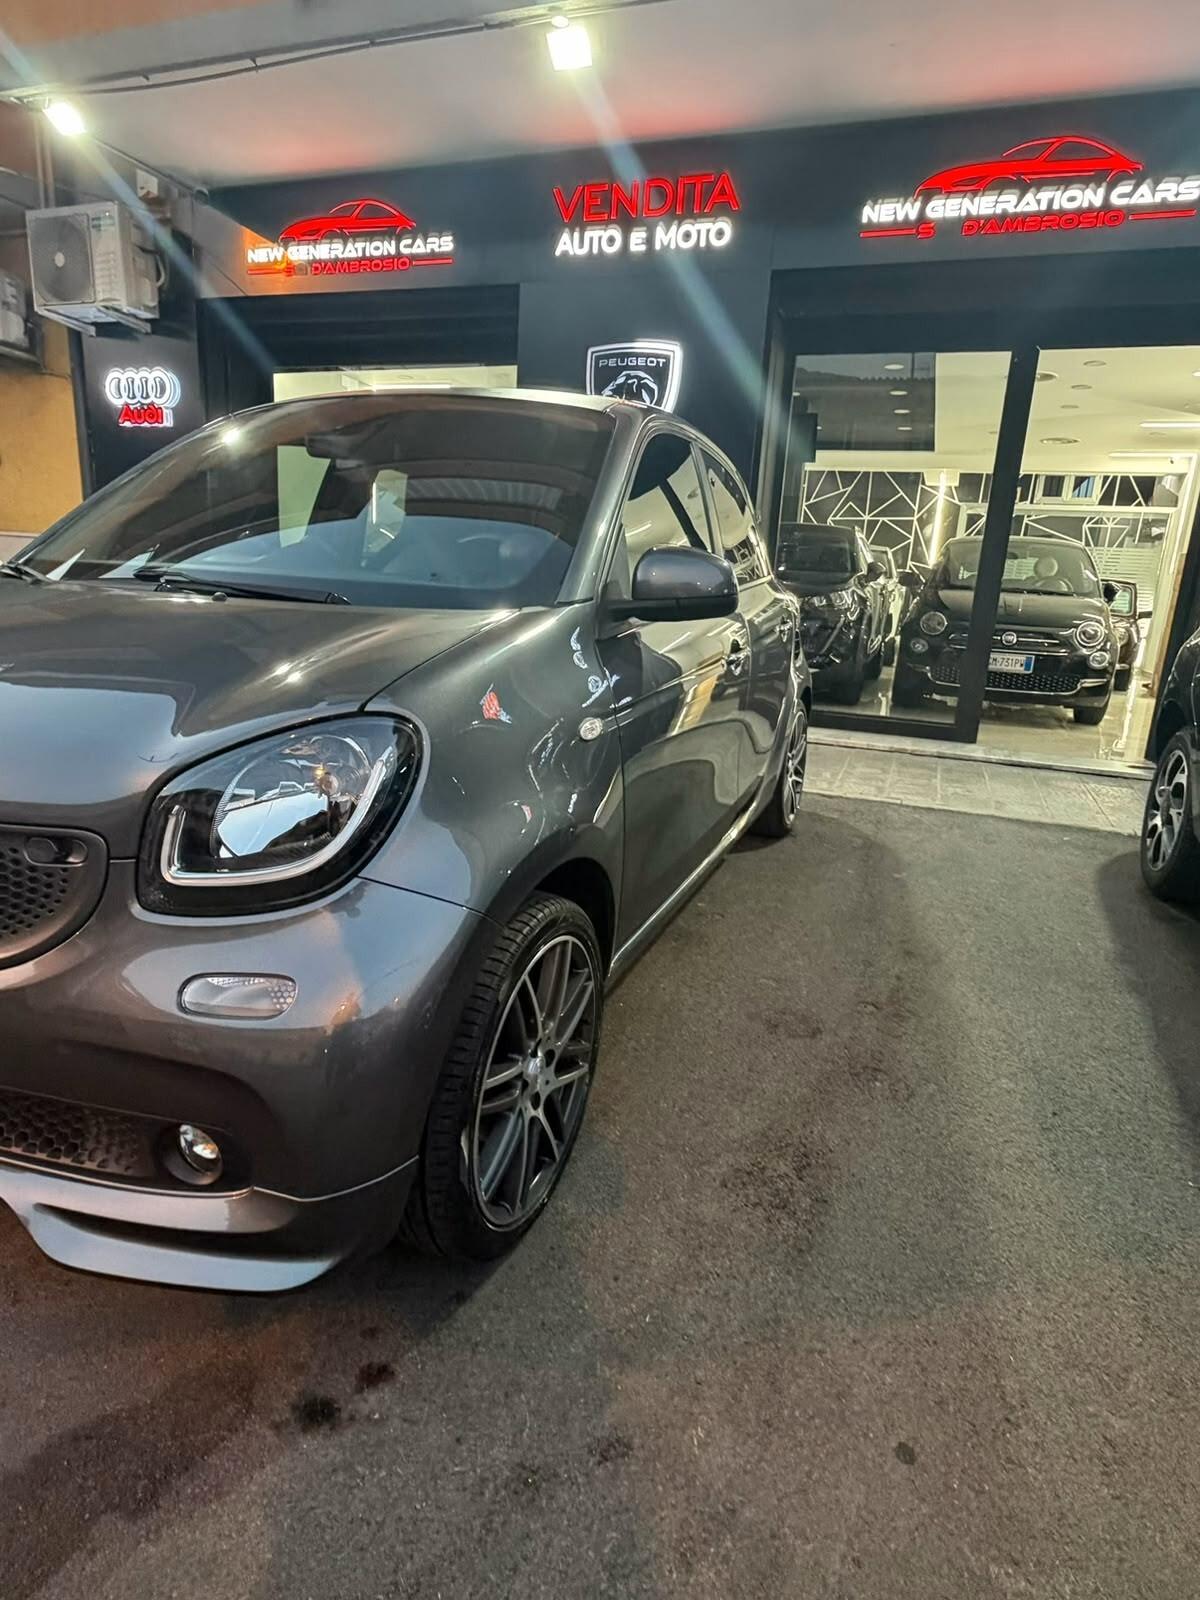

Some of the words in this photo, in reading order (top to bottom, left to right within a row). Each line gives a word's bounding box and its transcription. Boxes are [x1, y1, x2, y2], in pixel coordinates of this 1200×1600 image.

[553, 172, 740, 222] VENDITA
[862, 201, 921, 223] NEW
[925, 187, 1106, 218] GENERATION
[1109, 180, 1200, 206] CARS
[961, 209, 1125, 236] D'AMBROSIO
[247, 246, 286, 263] NEW
[287, 239, 396, 261] GENERATION
[399, 235, 454, 254] CARS
[555, 229, 622, 256] AUTO
[630, 232, 647, 252] E
[655, 222, 732, 250] MOTO
[311, 257, 409, 275] D'AMBROSIO
[599, 357, 666, 368] PEUGEOT
[118, 403, 164, 426] Audi
